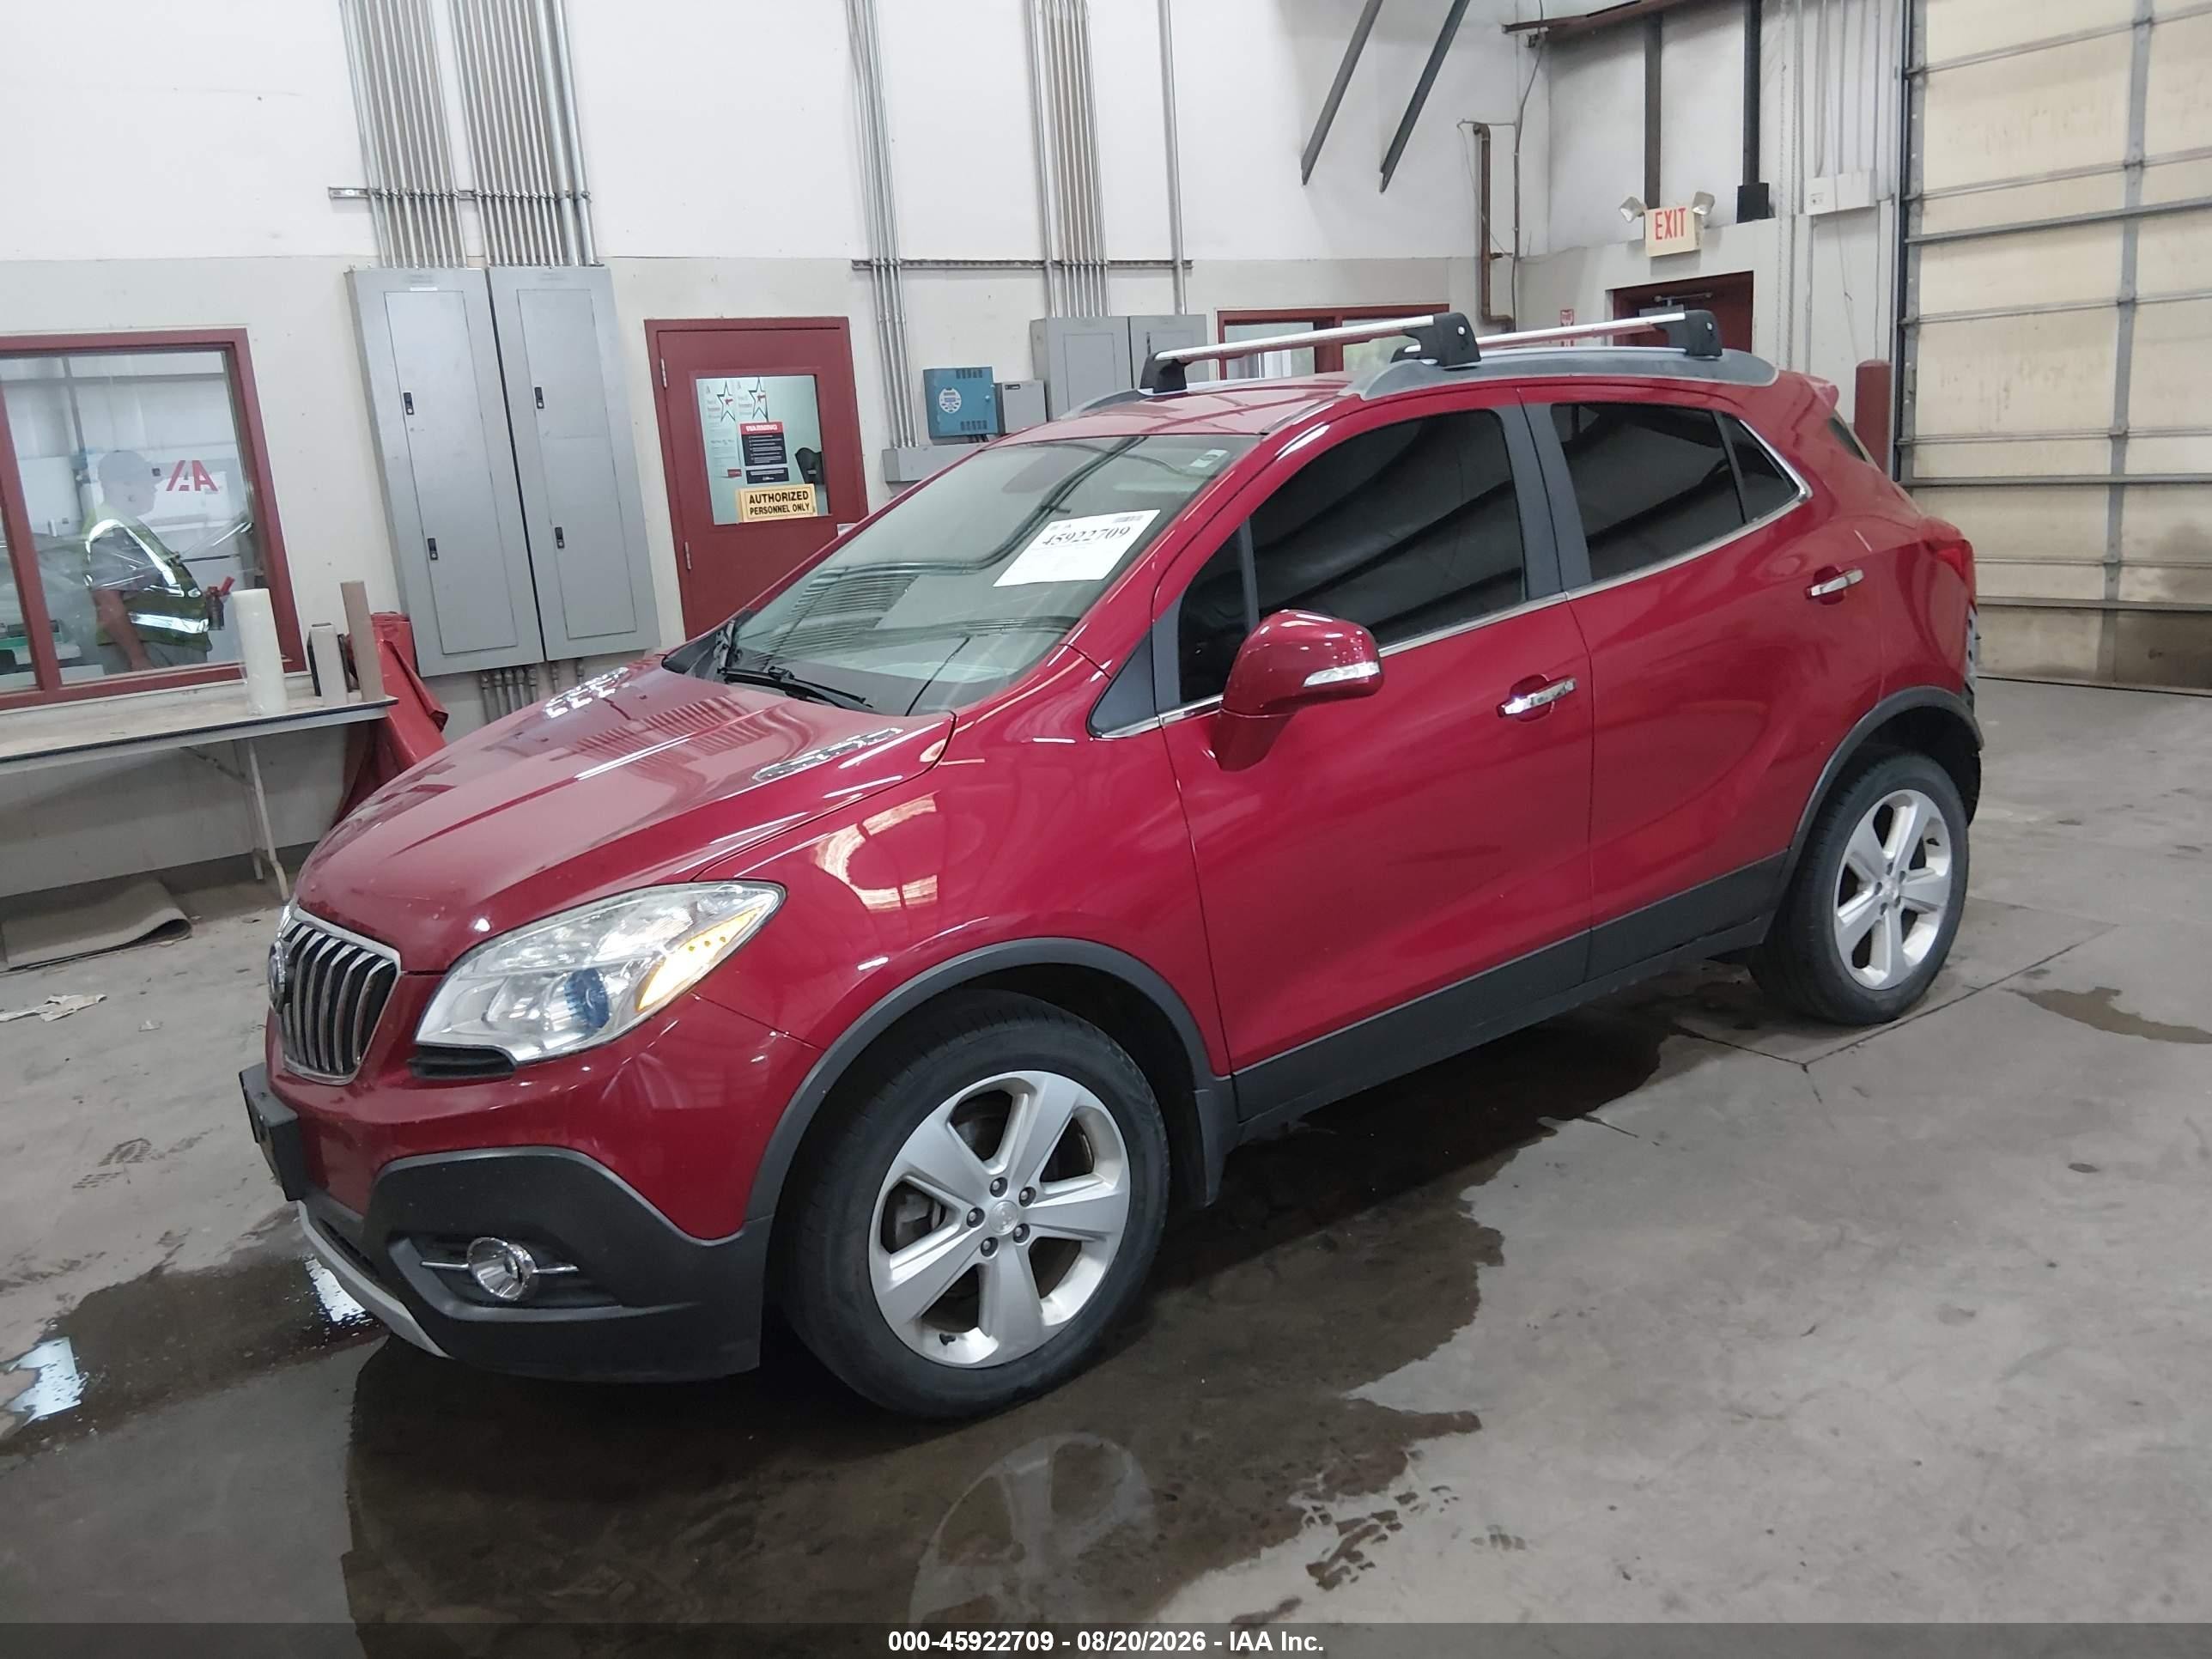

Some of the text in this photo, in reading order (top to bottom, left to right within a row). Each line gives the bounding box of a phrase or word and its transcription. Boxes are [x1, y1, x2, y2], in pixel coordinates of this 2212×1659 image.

[1655, 207, 1686, 240] EXIT
[749, 490, 809, 505] AUTHORIZED
[750, 502, 810, 515] PERSONNEL ONLY
[1042, 526, 1132, 545] 45922709
